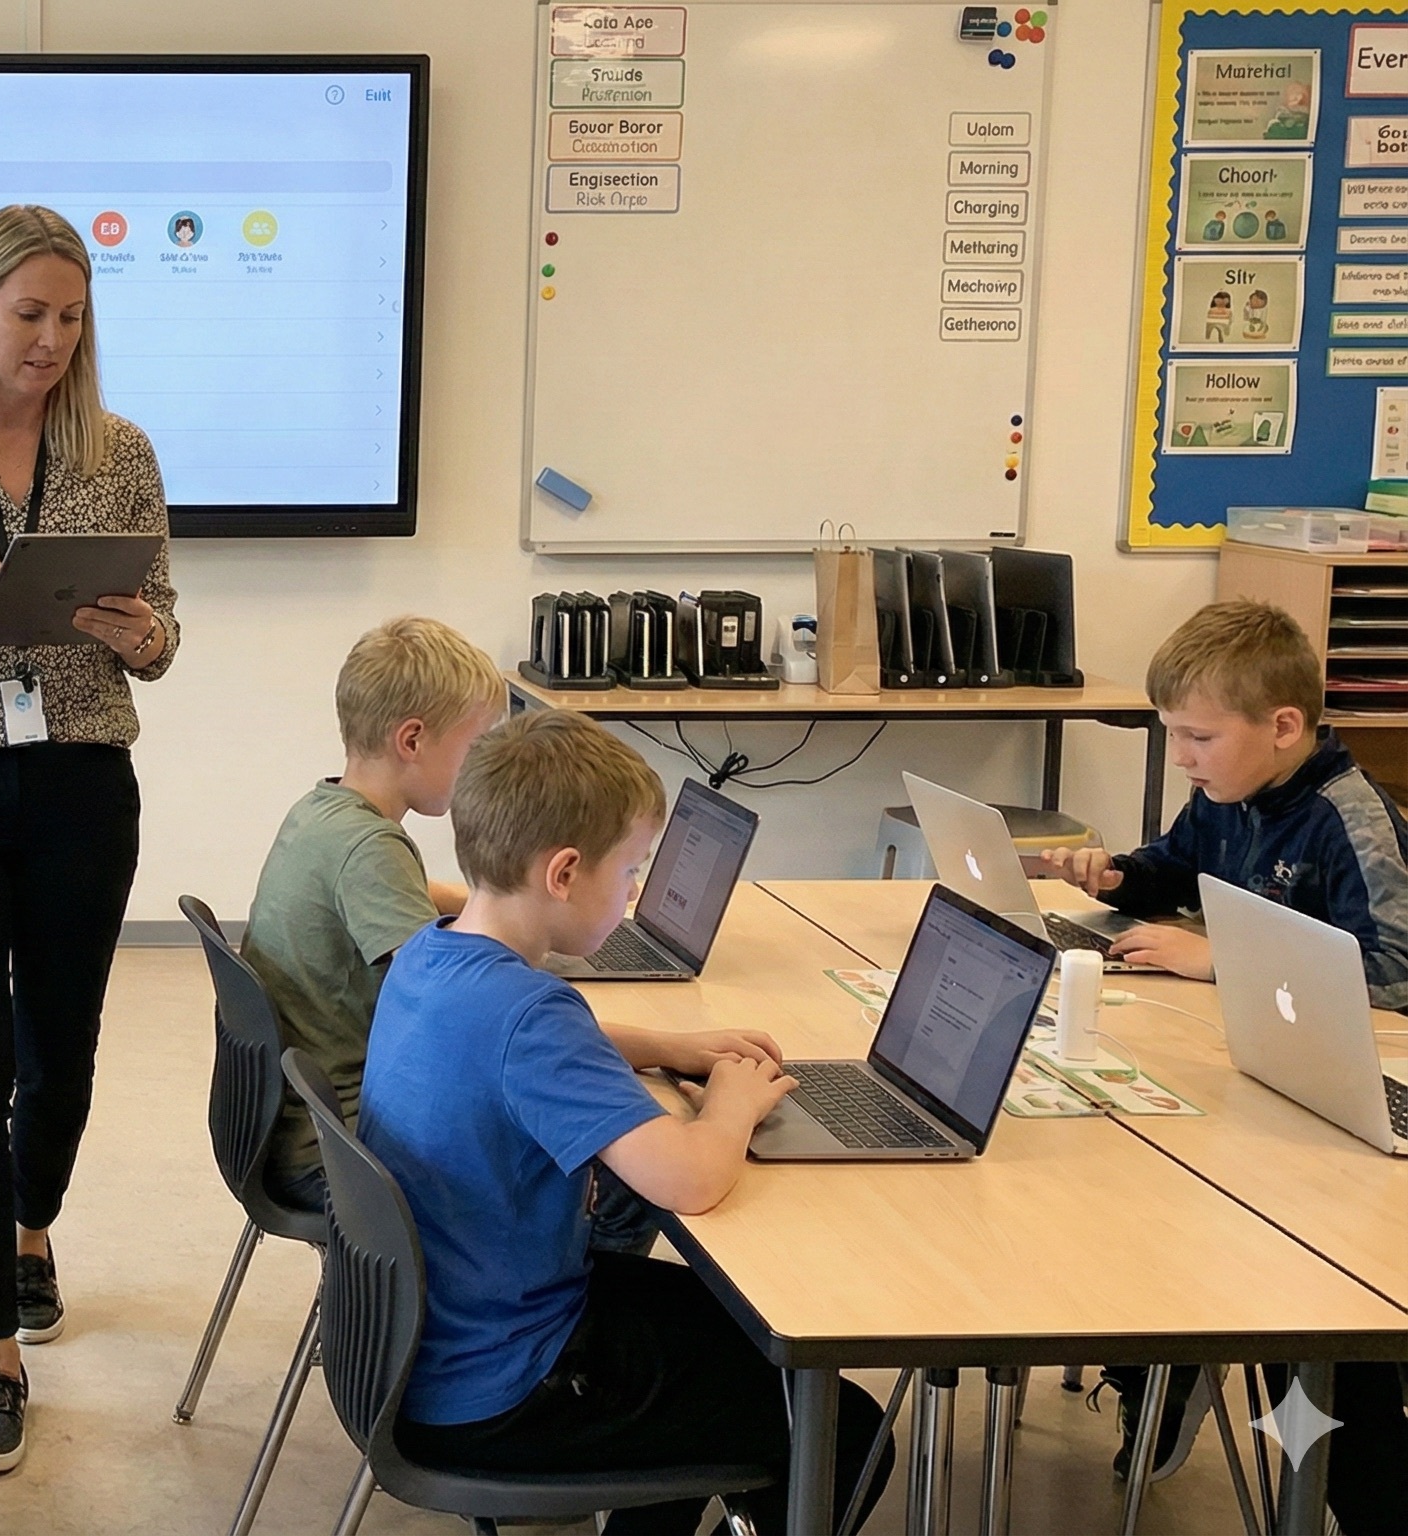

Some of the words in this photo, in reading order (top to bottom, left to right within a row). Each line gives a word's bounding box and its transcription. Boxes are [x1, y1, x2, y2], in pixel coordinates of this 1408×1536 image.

[959, 161, 1019, 178] Morning
[953, 200, 1020, 218] Charging
[1205, 373, 1260, 388] Hollow
